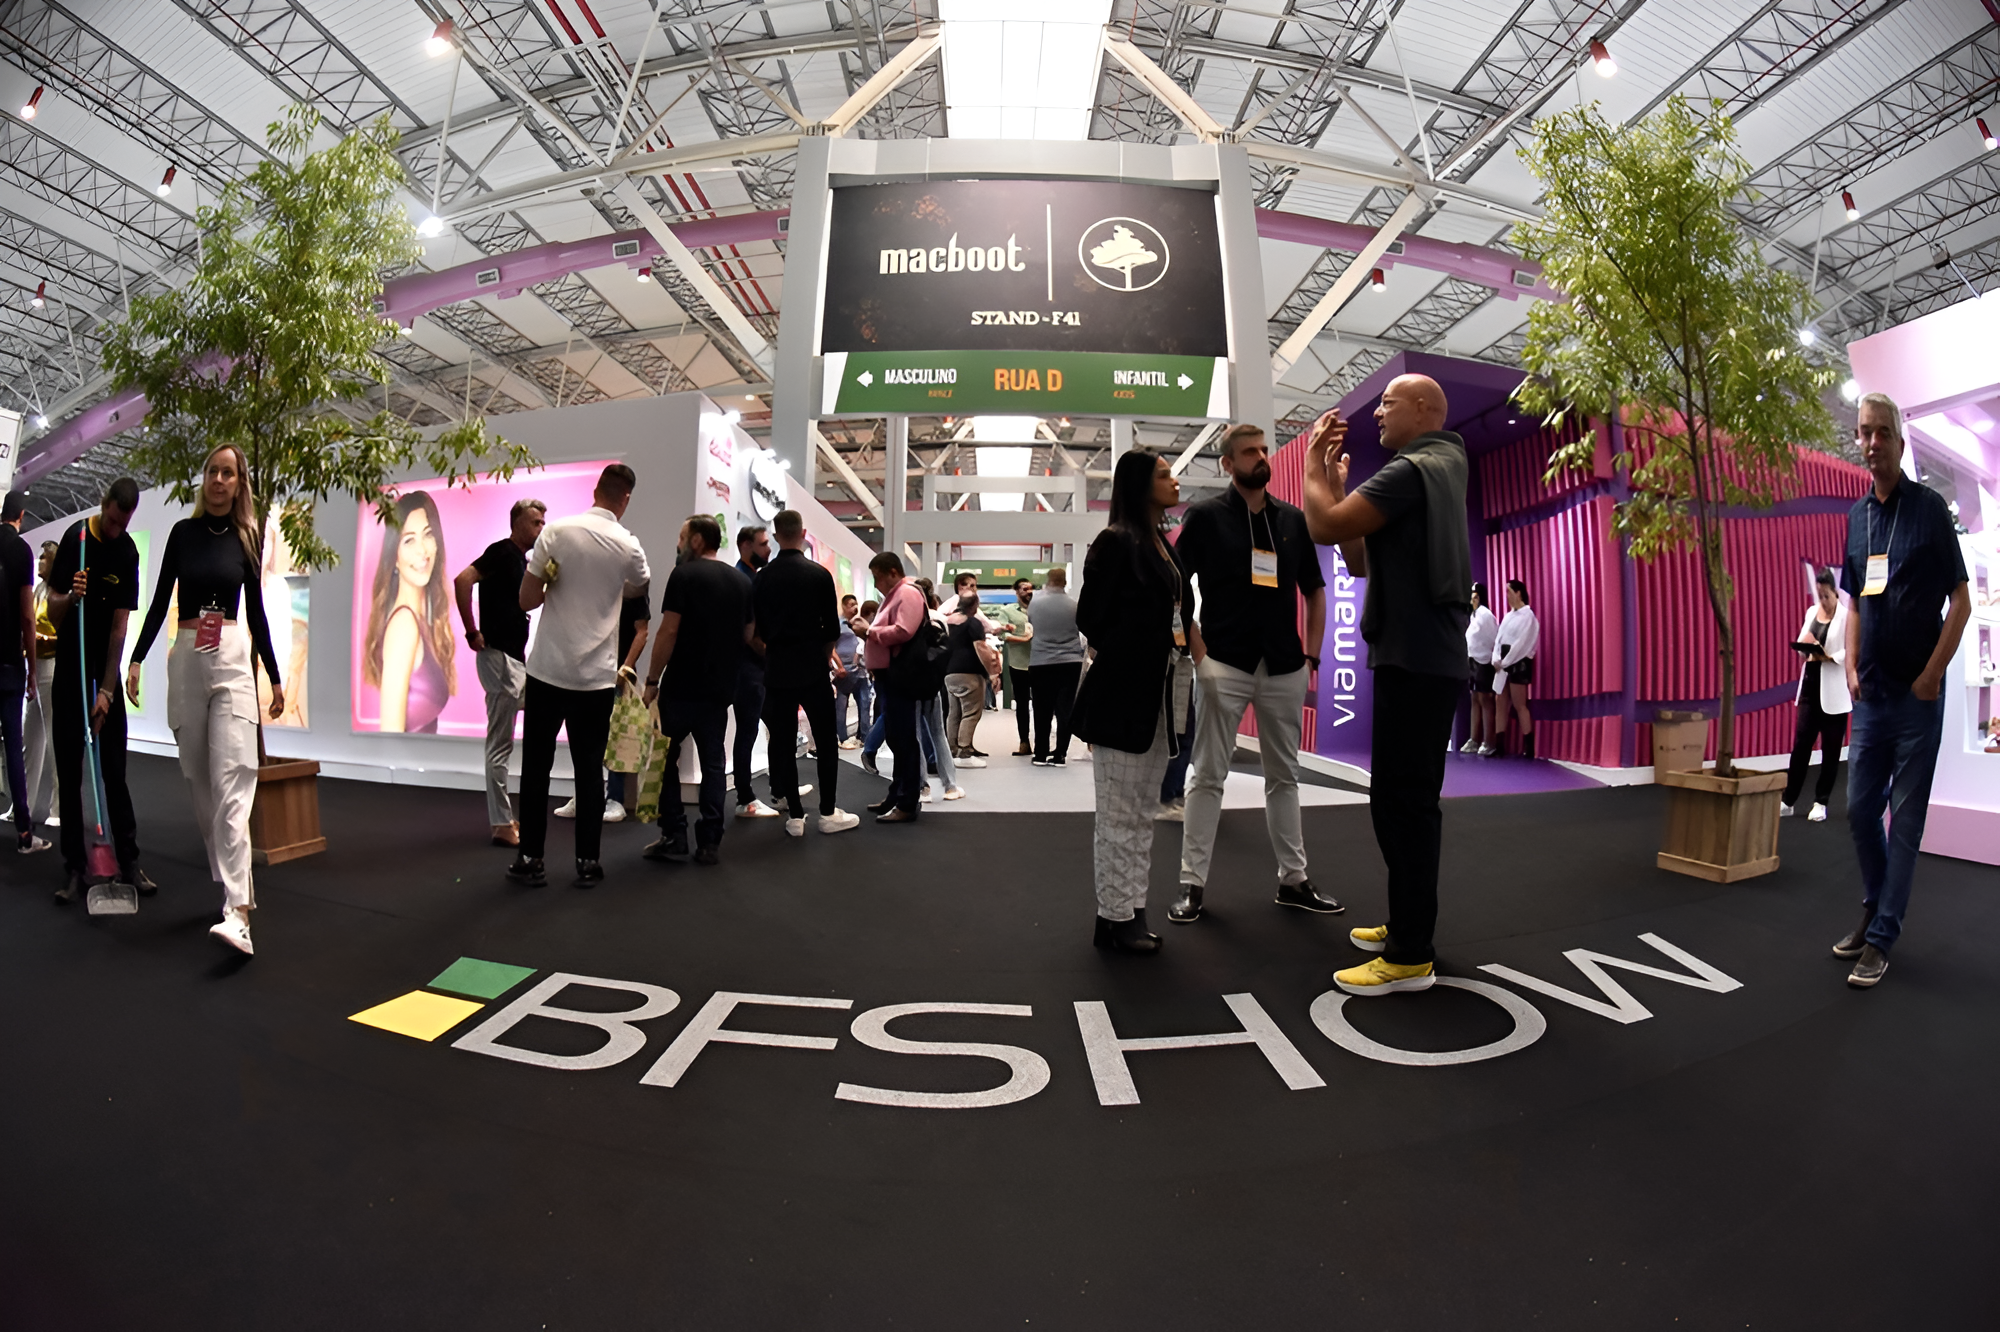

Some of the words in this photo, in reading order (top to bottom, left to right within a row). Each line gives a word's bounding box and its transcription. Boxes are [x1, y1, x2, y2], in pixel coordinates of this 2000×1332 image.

[879, 232, 1026, 274] macboot
[970, 310, 1041, 326] STAND
[1051, 311, 1081, 326] F41
[884, 368, 957, 385] MASCULINO
[994, 368, 1040, 391] RUA
[1047, 369, 1063, 392] D
[1113, 370, 1169, 387] INFANTIL
[451, 932, 1744, 1108] BFSHOW
